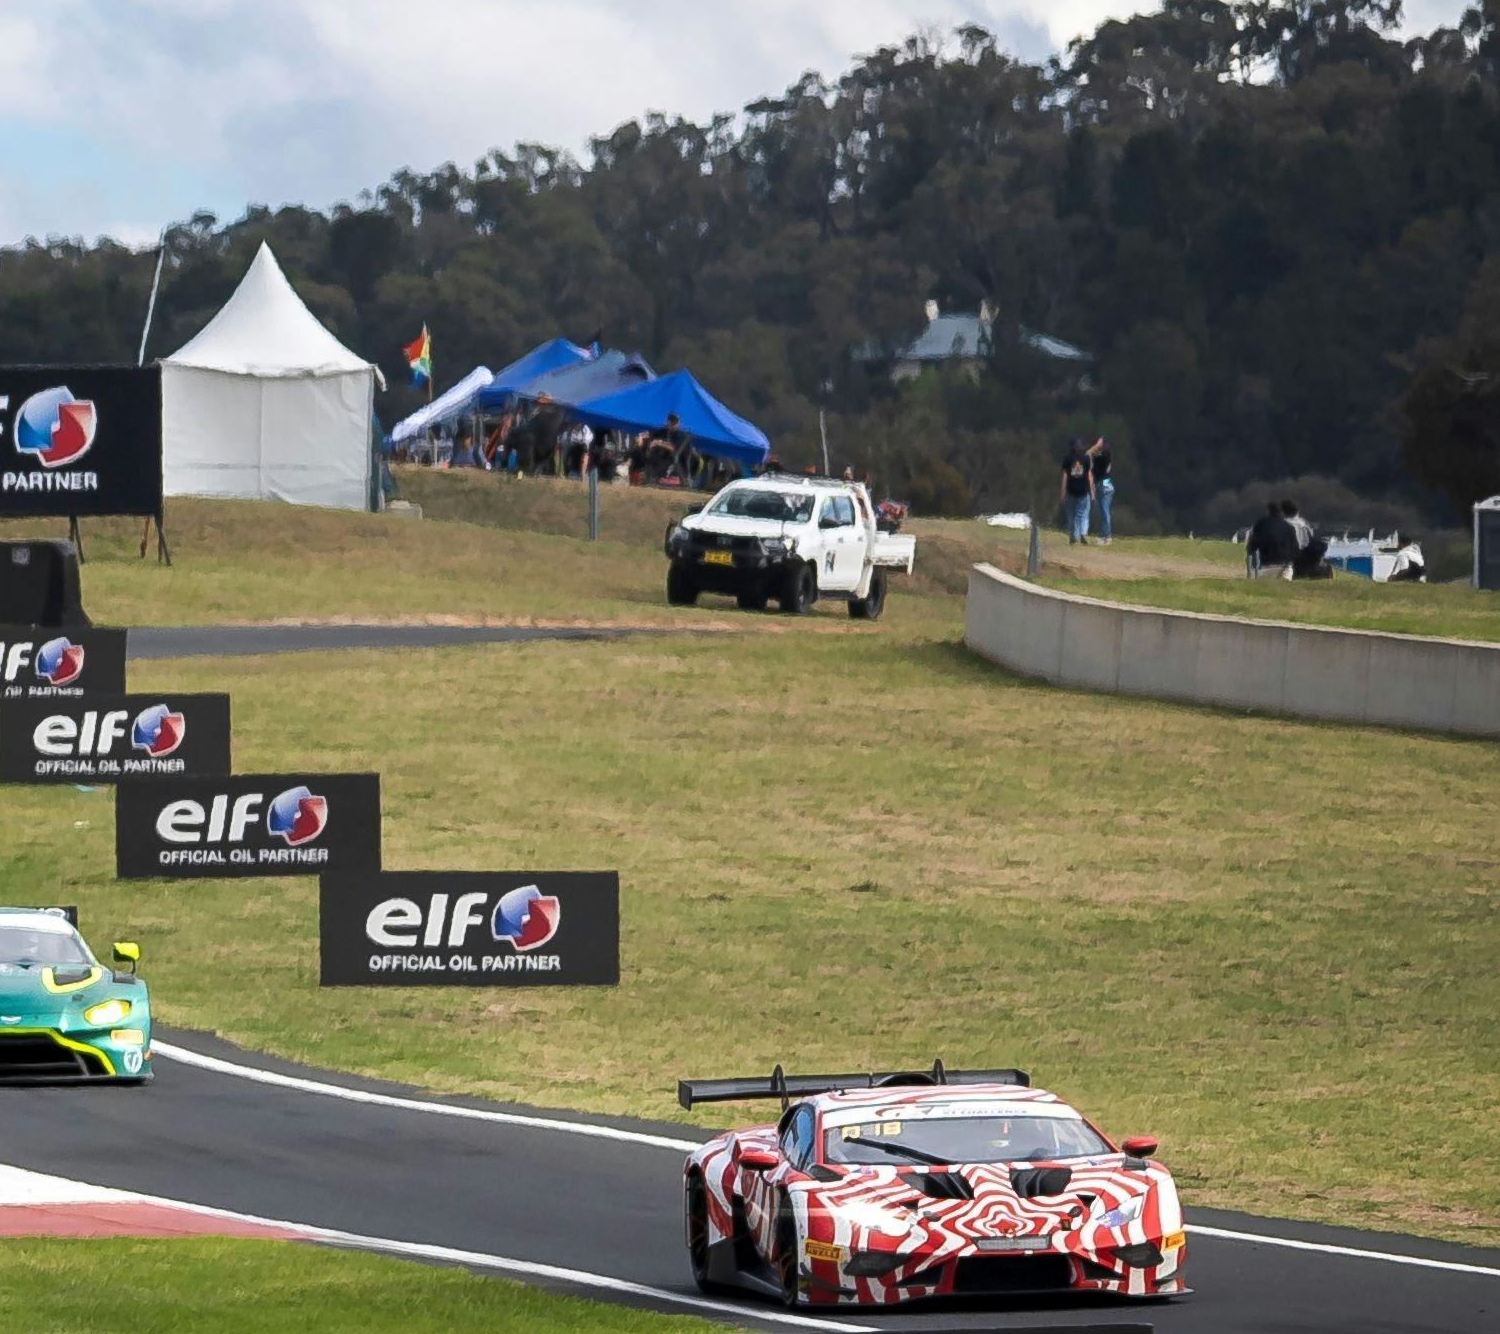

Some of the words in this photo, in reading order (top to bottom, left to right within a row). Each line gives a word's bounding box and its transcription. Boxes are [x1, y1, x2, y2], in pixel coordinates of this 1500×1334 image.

[2, 471, 98, 491] PARTNER
[33, 711, 129, 756] elf
[35, 760, 94, 774] OFFICIAL
[124, 759, 185, 773] PARTNER
[155, 793, 263, 844] elf
[160, 850, 227, 865] OFFICIAL
[230, 849, 256, 864] OIL
[259, 848, 329, 863] PARTNER
[366, 892, 488, 948] elf
[369, 956, 446, 971] OFFICIAL
[450, 955, 478, 971] OIL
[482, 954, 561, 971] PARTNER
